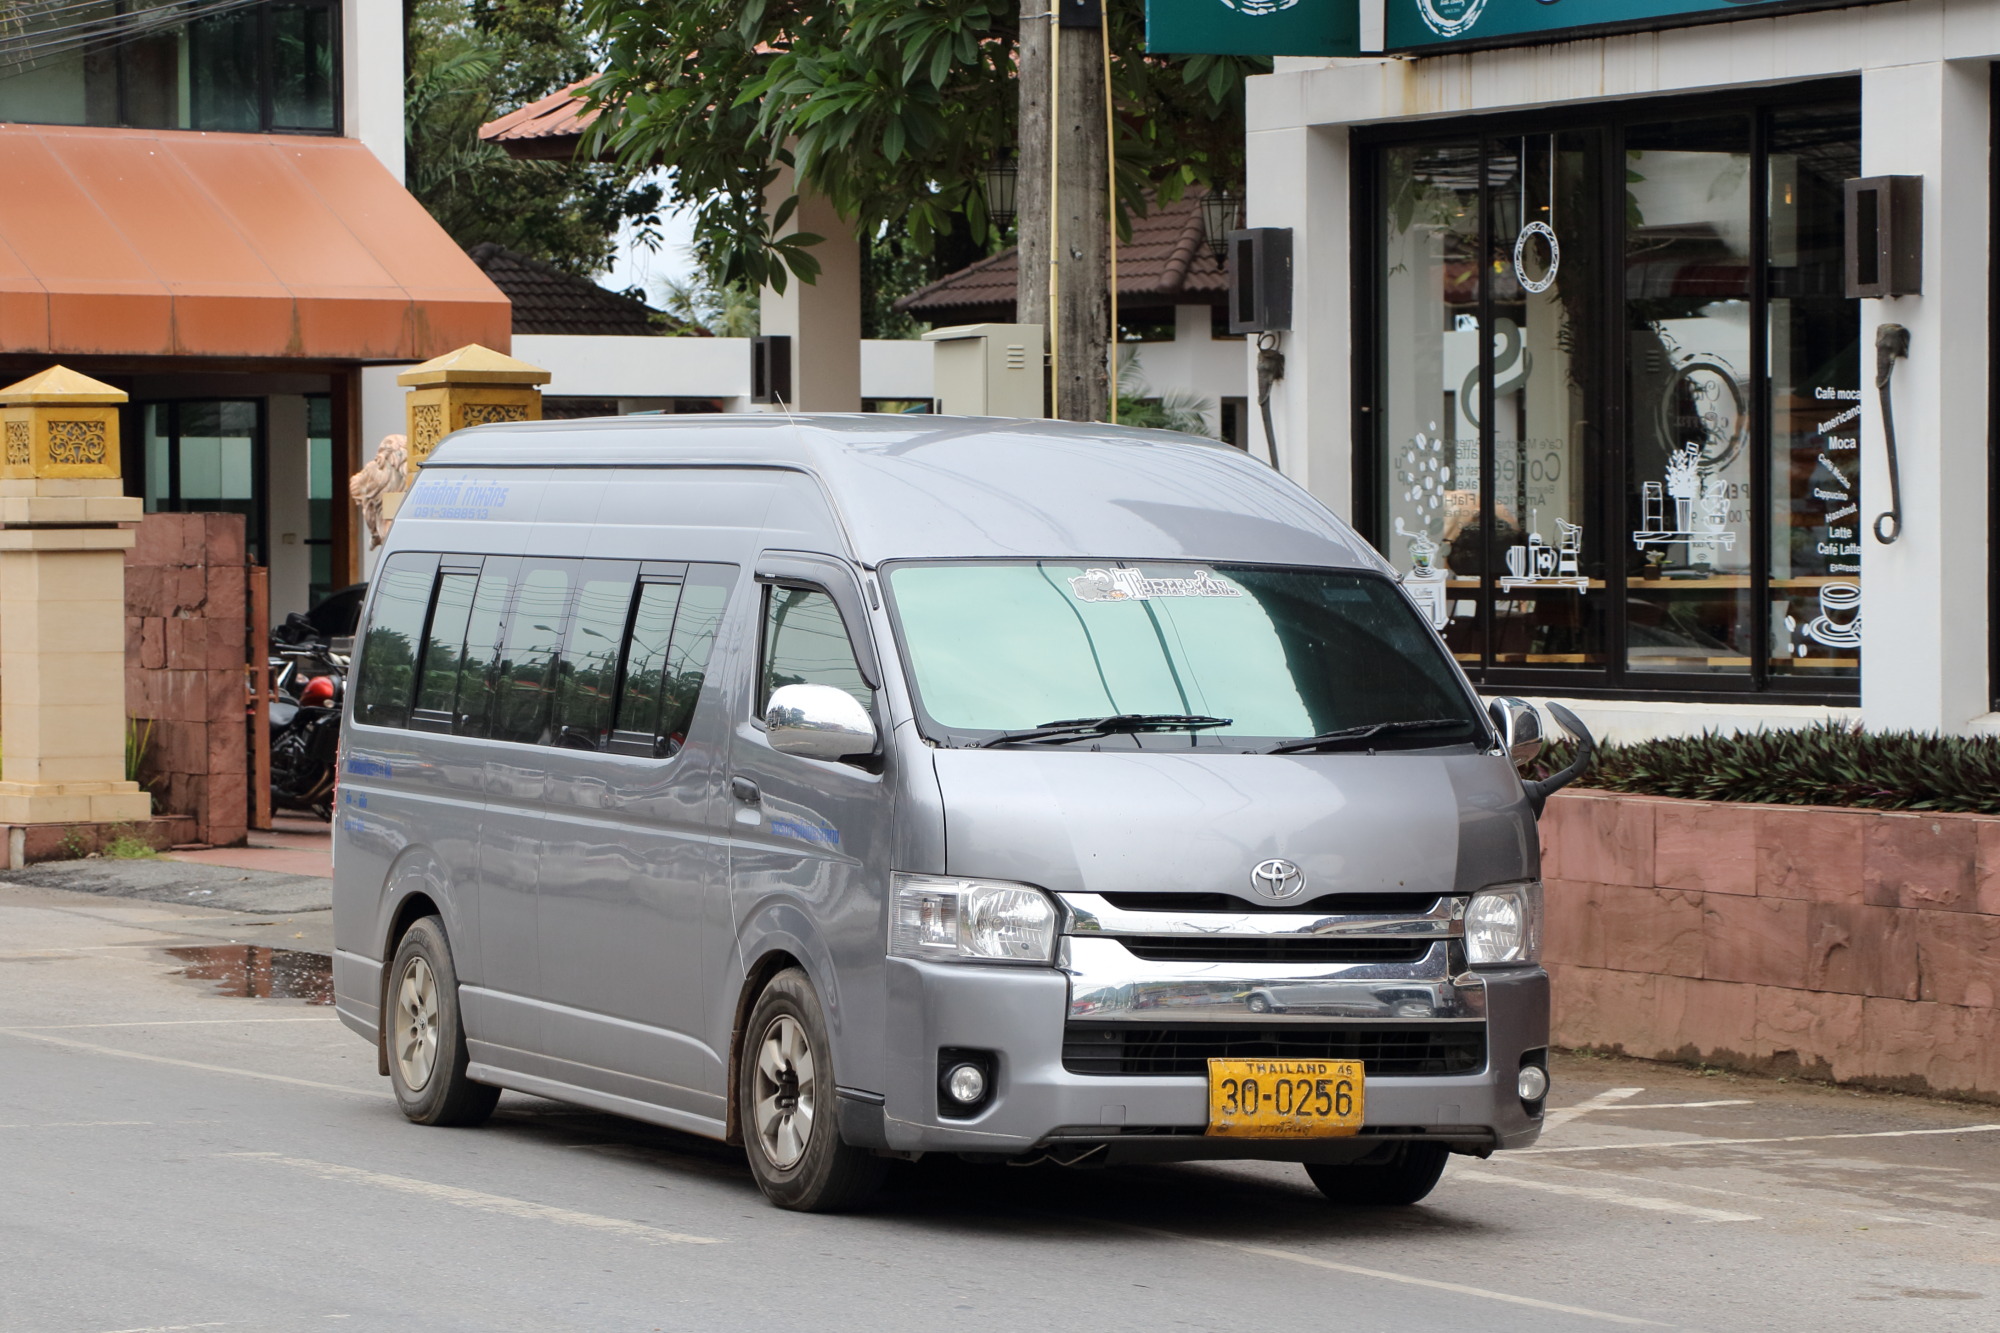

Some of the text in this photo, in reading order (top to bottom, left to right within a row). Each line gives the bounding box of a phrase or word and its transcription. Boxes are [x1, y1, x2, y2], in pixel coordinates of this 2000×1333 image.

[1837, 389, 1861, 400] moca
[1818, 404, 1861, 435] Americano
[1828, 436, 1857, 450] Moca
[1825, 503, 1858, 523] Hazelnut
[1829, 526, 1853, 539] Latte
[1839, 543, 1861, 555] Latte
[1246, 1063, 1327, 1075] THAILAND
[1221, 1078, 1353, 1117] 30-0256
